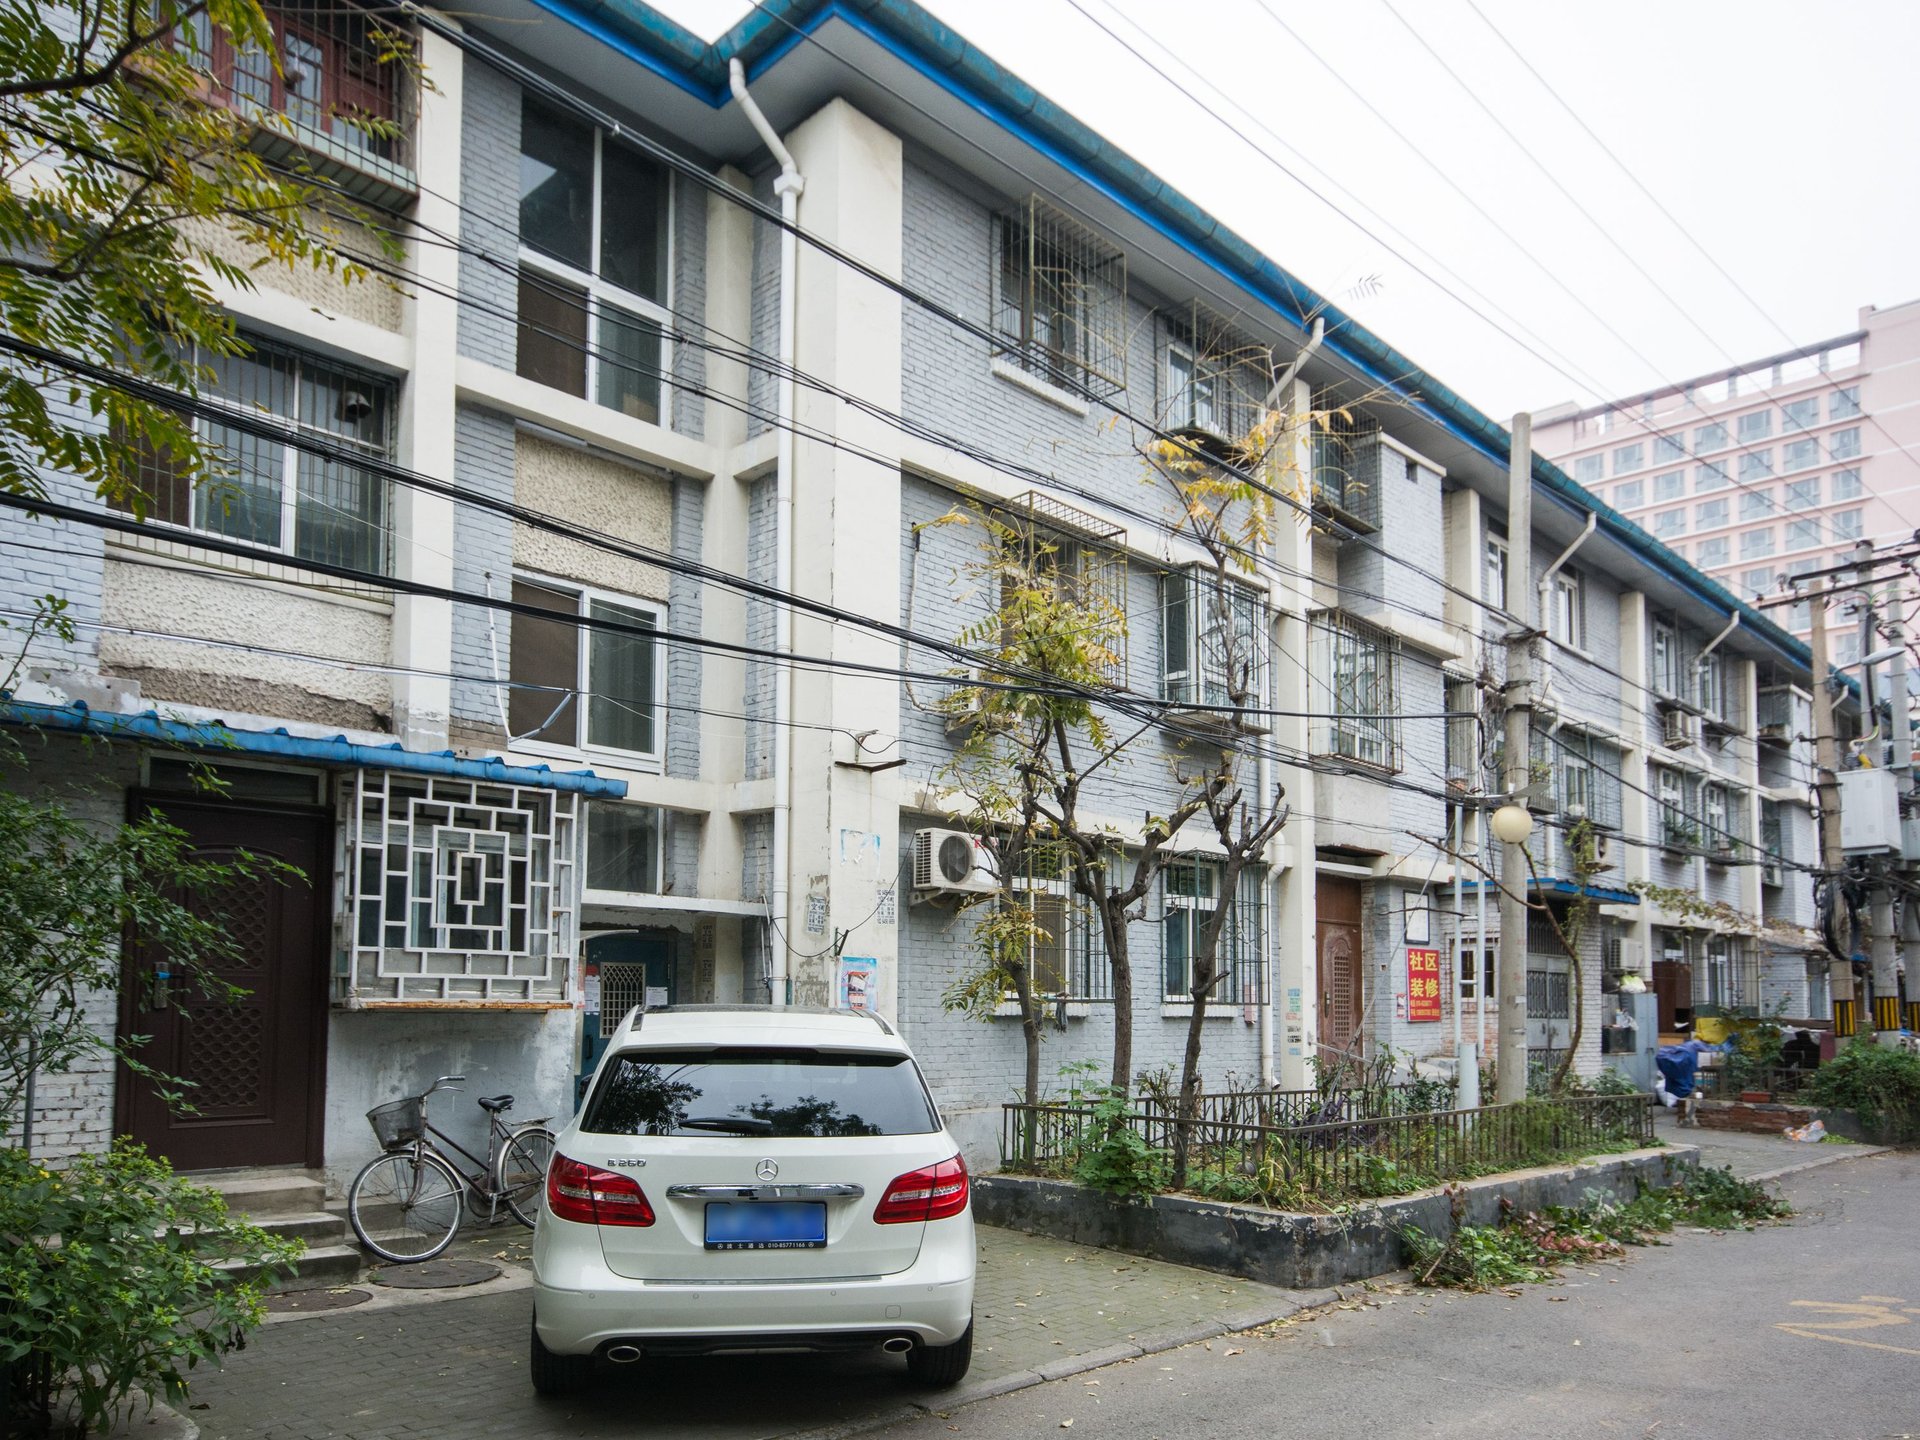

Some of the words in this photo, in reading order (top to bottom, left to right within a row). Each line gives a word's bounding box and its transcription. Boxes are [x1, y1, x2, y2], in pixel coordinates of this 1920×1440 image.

[1409, 951, 1438, 972] 社区
[1410, 977, 1439, 998] 装修
[607, 1158, 616, 1167] B
[618, 1158, 647, 1167] 260
